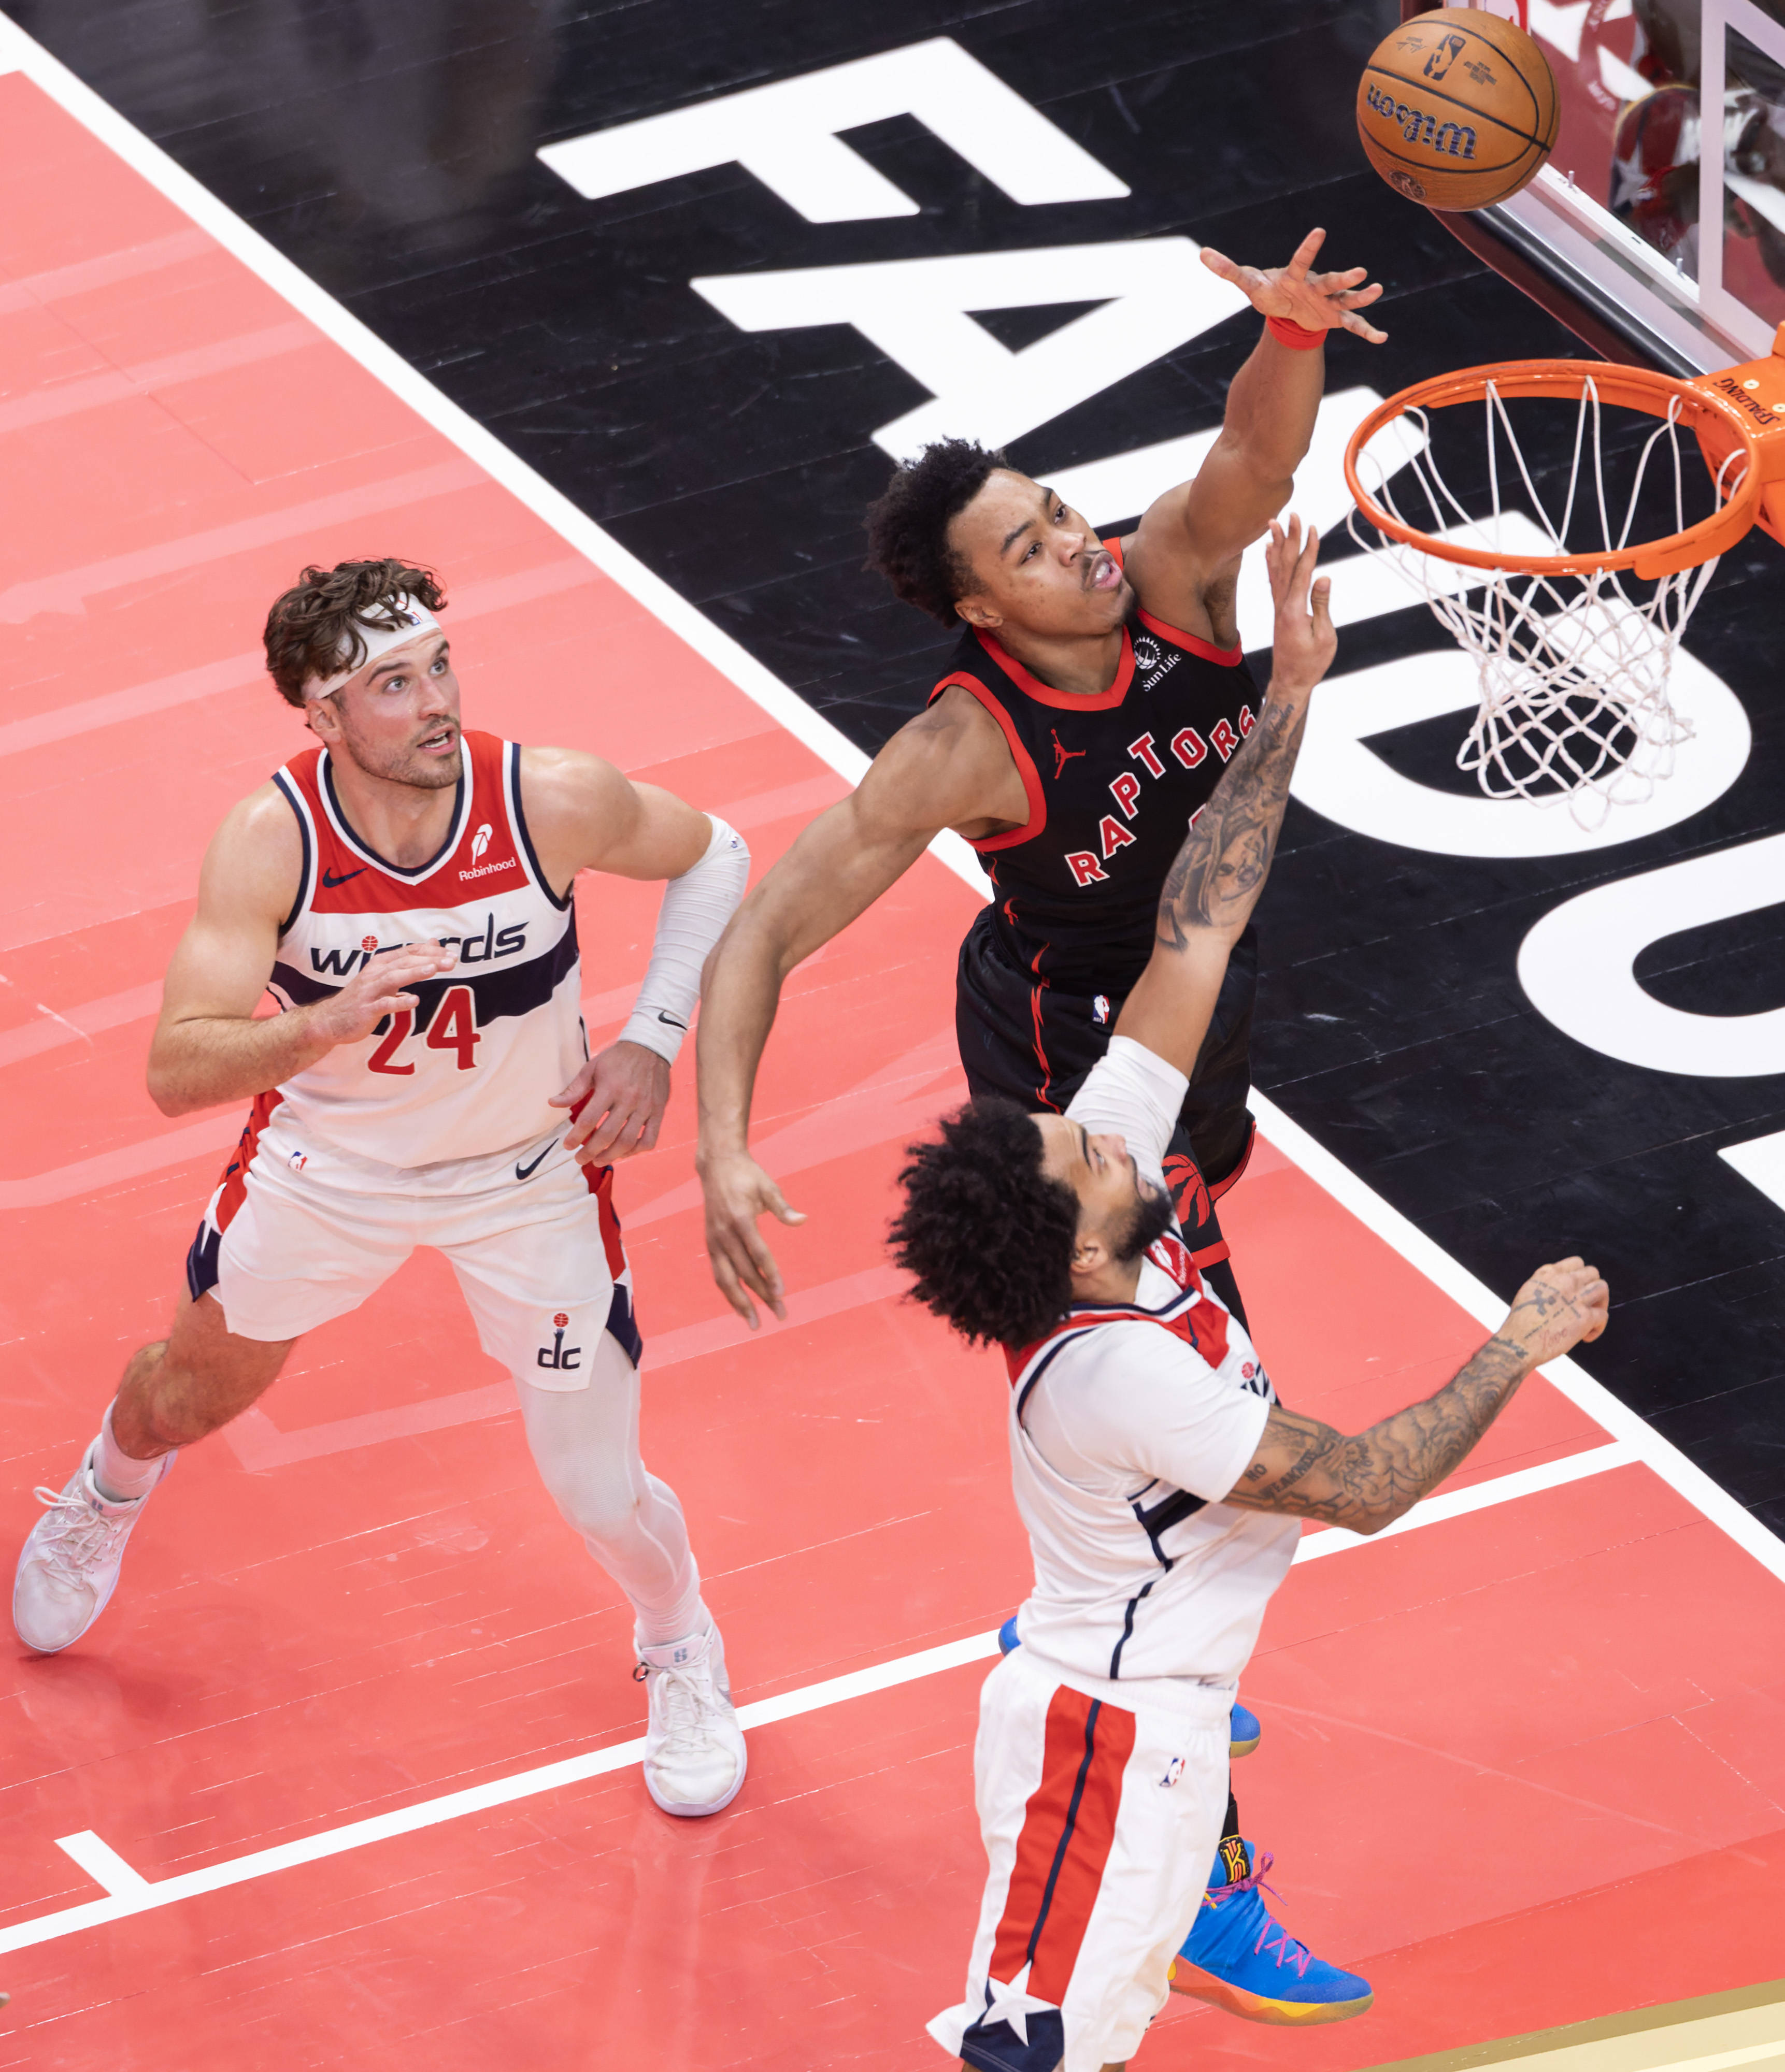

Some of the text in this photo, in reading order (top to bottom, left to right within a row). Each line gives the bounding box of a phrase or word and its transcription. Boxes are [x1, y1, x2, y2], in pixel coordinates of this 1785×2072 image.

[1366, 82, 1477, 160] Wilson
[1712, 378, 1781, 425] SPALDING
[536, 36, 1785, 1213] FANDU
[1141, 653, 1182, 692] Sun Life
[458, 856, 517, 882] Robinhood
[367, 984, 482, 1076] 24
